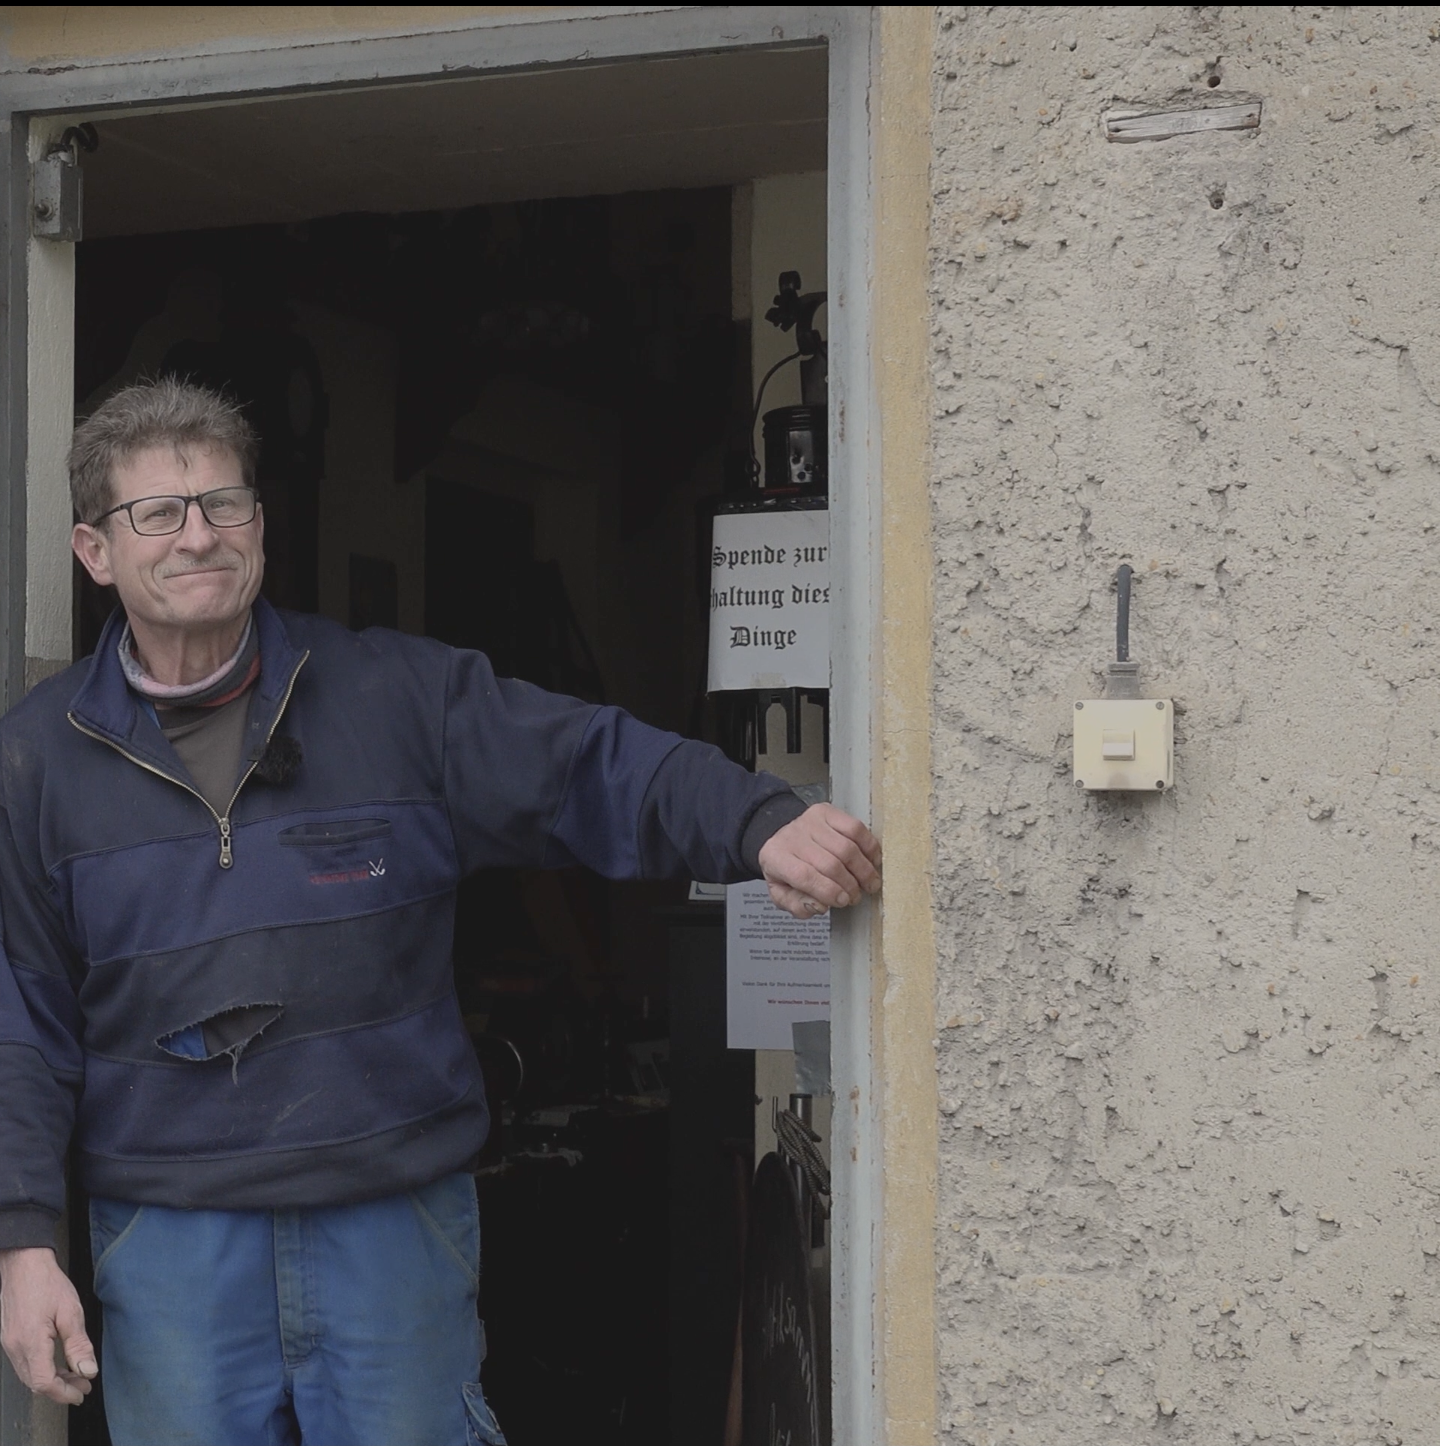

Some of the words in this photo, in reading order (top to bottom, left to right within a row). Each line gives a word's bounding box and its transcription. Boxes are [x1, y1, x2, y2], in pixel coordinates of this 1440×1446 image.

[712, 544, 787, 570] Spende
[793, 546, 828, 568] zur
[729, 625, 798, 650] Dinge
